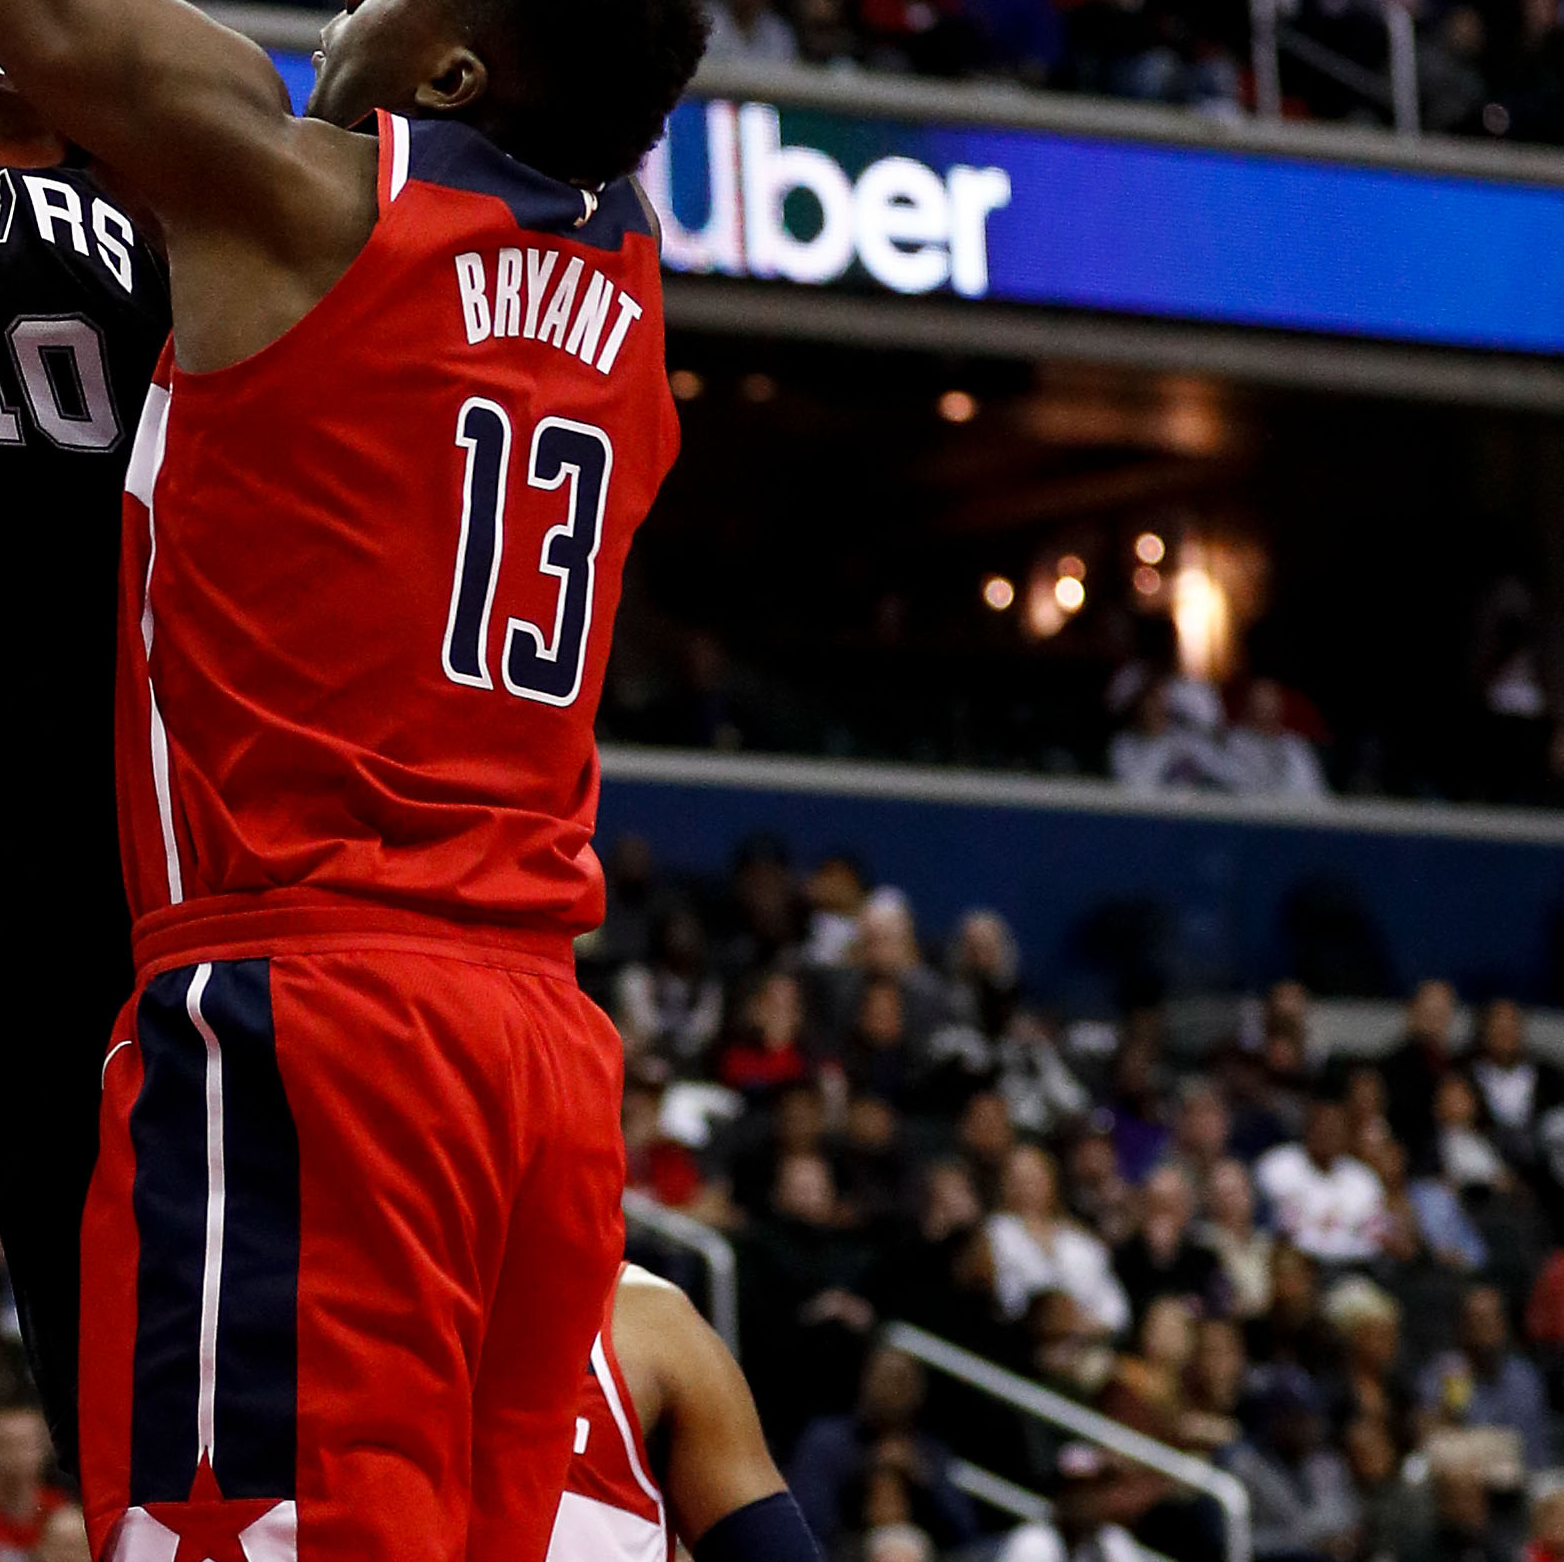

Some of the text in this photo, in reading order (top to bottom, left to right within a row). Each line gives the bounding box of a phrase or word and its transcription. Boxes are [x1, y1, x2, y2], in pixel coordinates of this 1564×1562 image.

[638, 99, 1012, 299] Uber
[455, 247, 642, 377] BRYANT
[442, 395, 614, 707] 13
